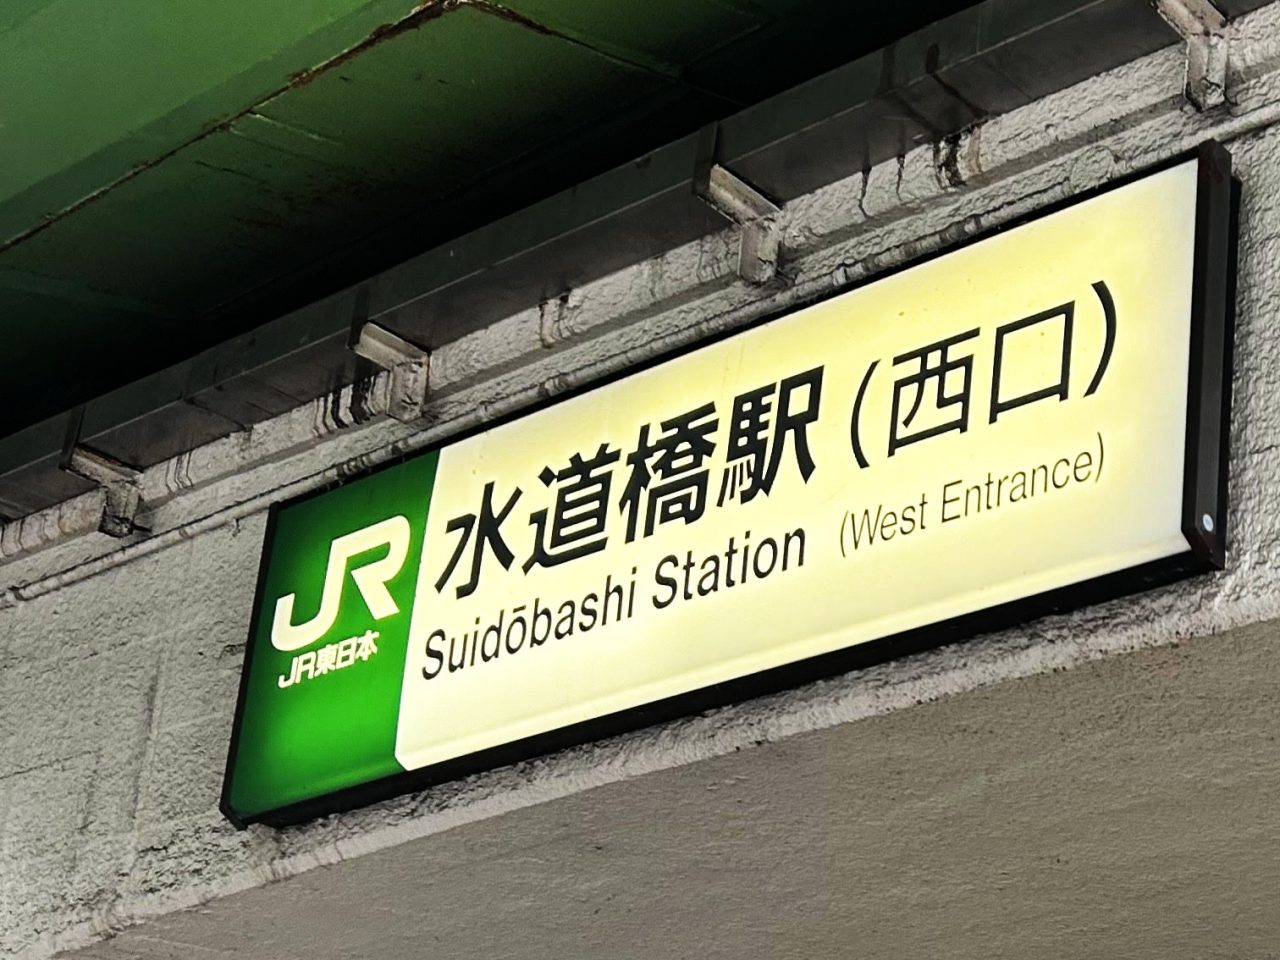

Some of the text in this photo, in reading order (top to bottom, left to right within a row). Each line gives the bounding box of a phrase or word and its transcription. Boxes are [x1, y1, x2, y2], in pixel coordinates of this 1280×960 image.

[271, 515, 411, 652] JR
[421, 432, 1105, 681] Suidōbashi Station (West Entrance)
[278, 630, 380, 689] JR東日本
